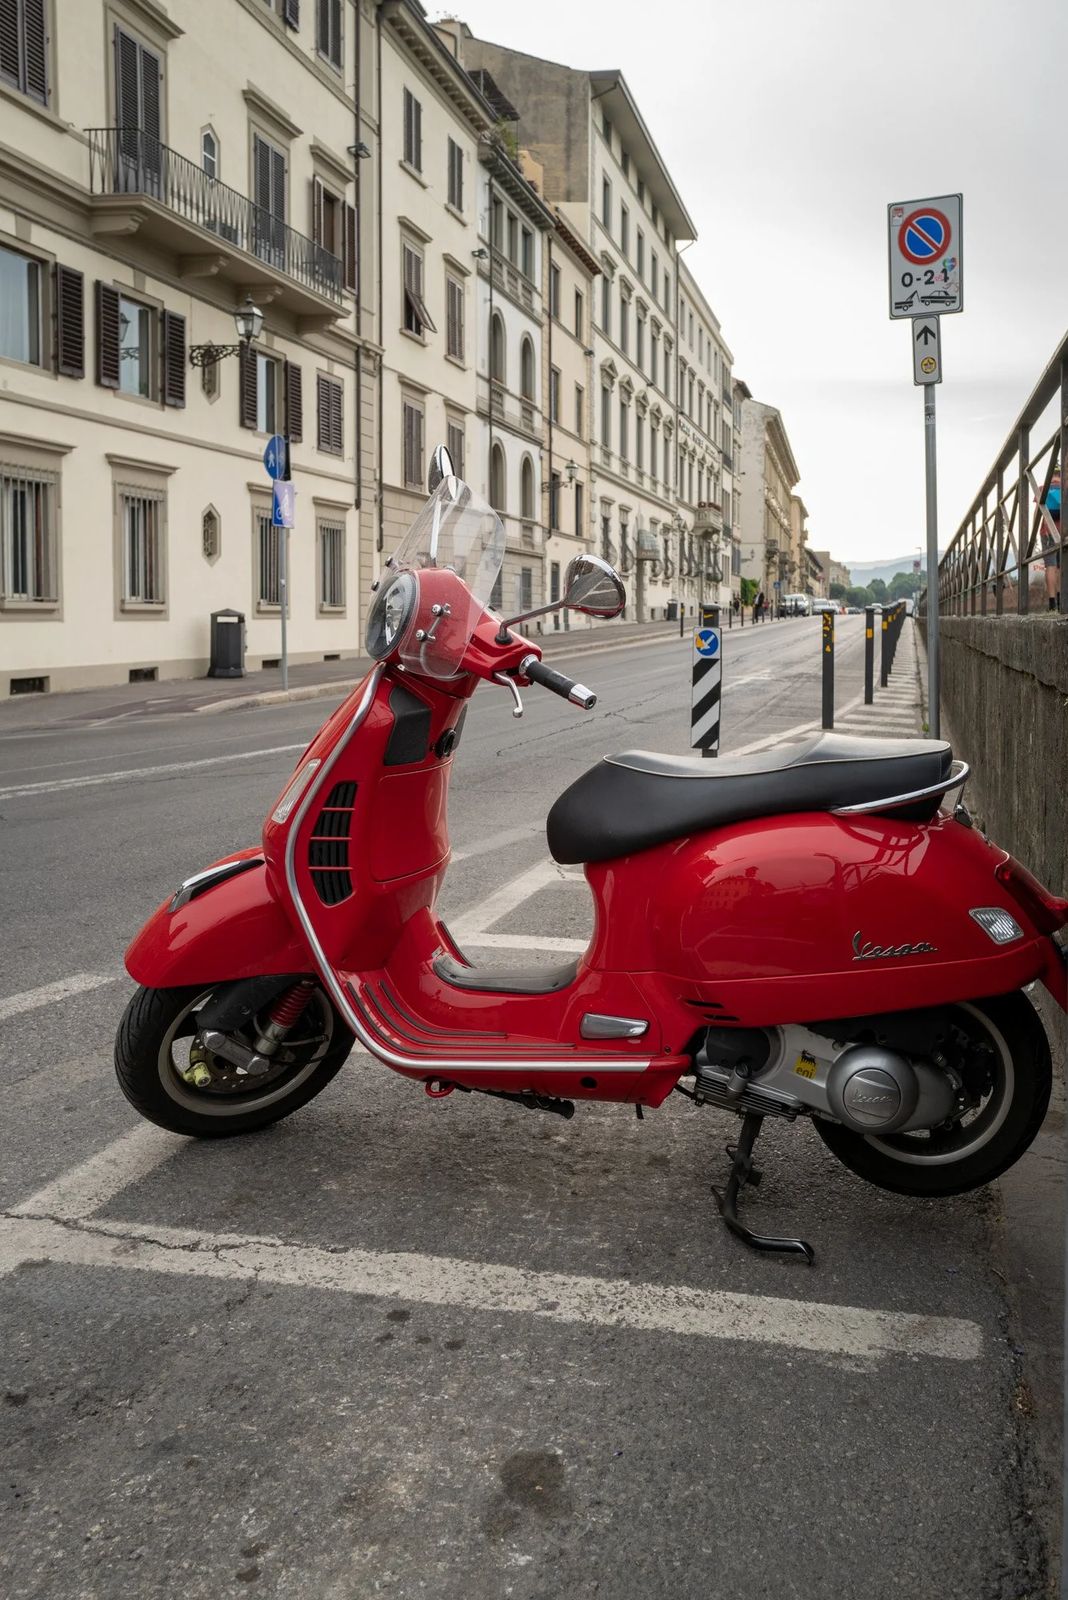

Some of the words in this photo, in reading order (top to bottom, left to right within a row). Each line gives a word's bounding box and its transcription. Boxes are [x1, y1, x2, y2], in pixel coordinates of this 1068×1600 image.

[901, 268, 950, 288] 0-21
[851, 930, 939, 961] Vespa
[796, 1066, 815, 1079] eni
